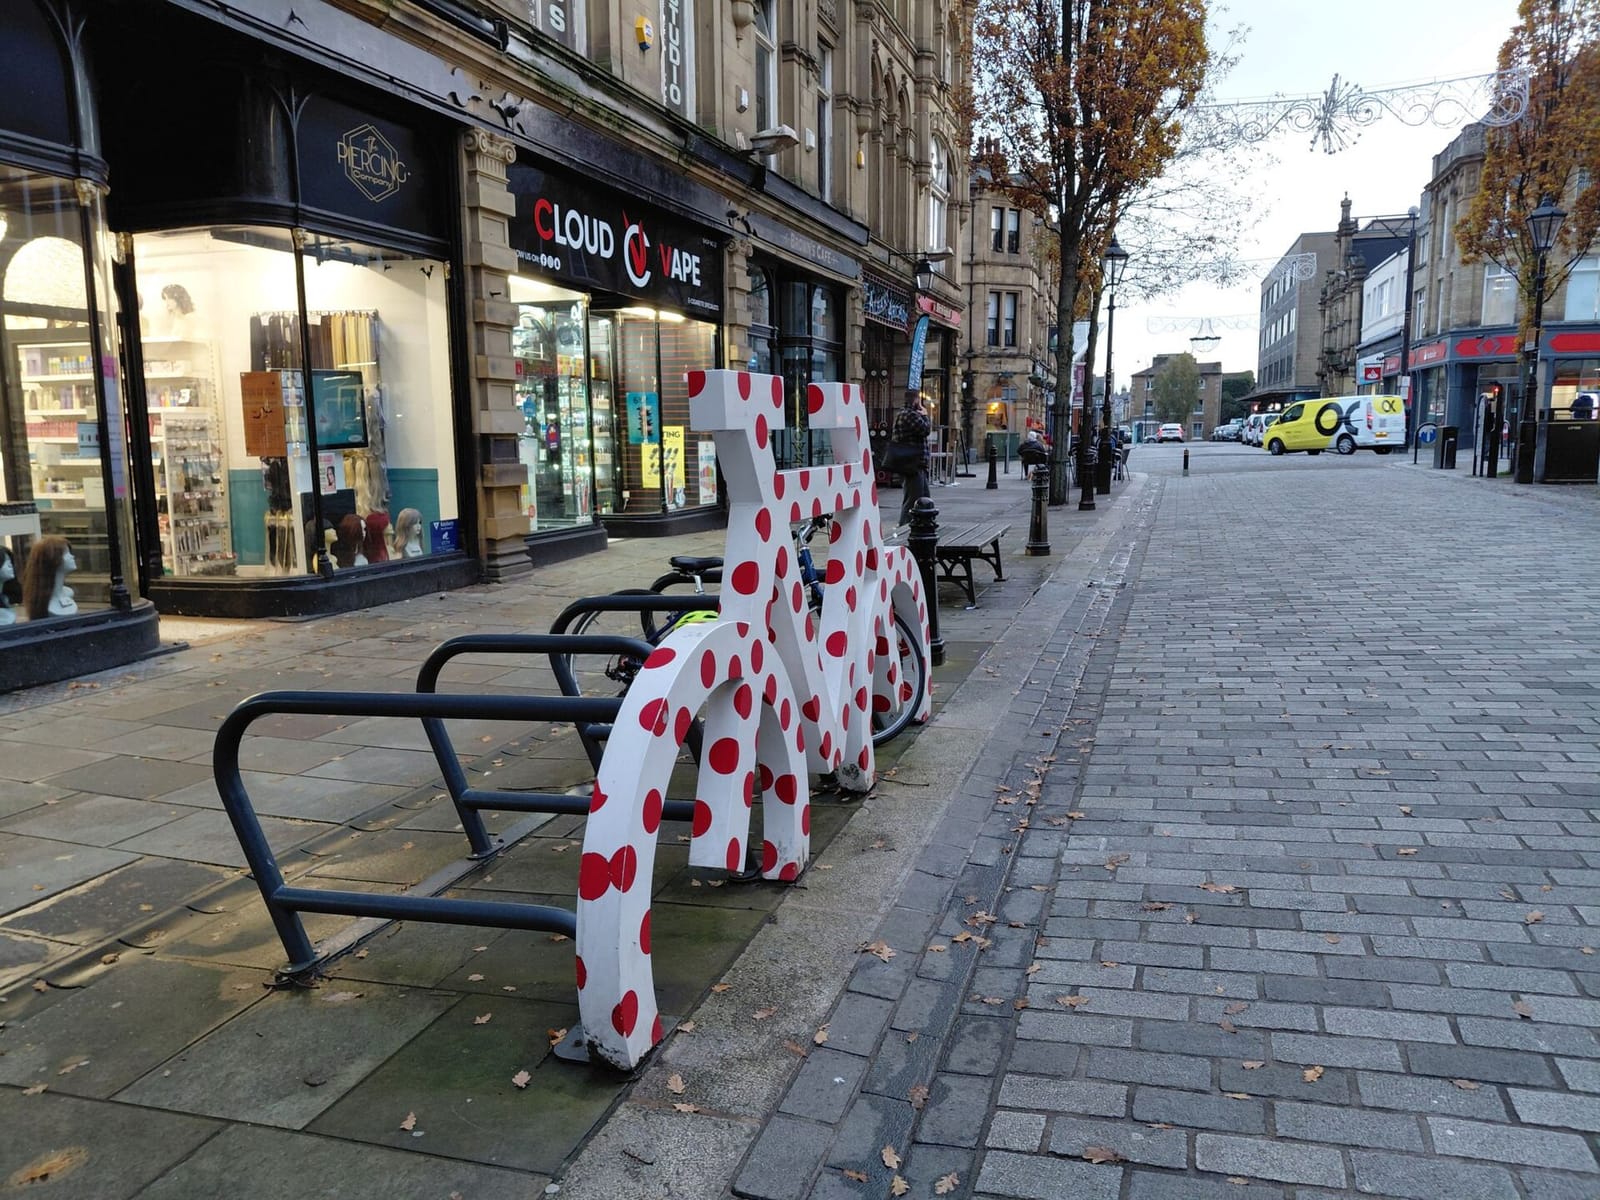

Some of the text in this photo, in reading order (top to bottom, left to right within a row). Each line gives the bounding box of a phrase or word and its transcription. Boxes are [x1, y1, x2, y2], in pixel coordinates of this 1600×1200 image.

[550, 0, 565, 32] S
[337, 142, 406, 183] PIERCING
[352, 169, 394, 189] Company
[534, 198, 614, 259] CLOUD
[659, 242, 701, 287] VAPE
